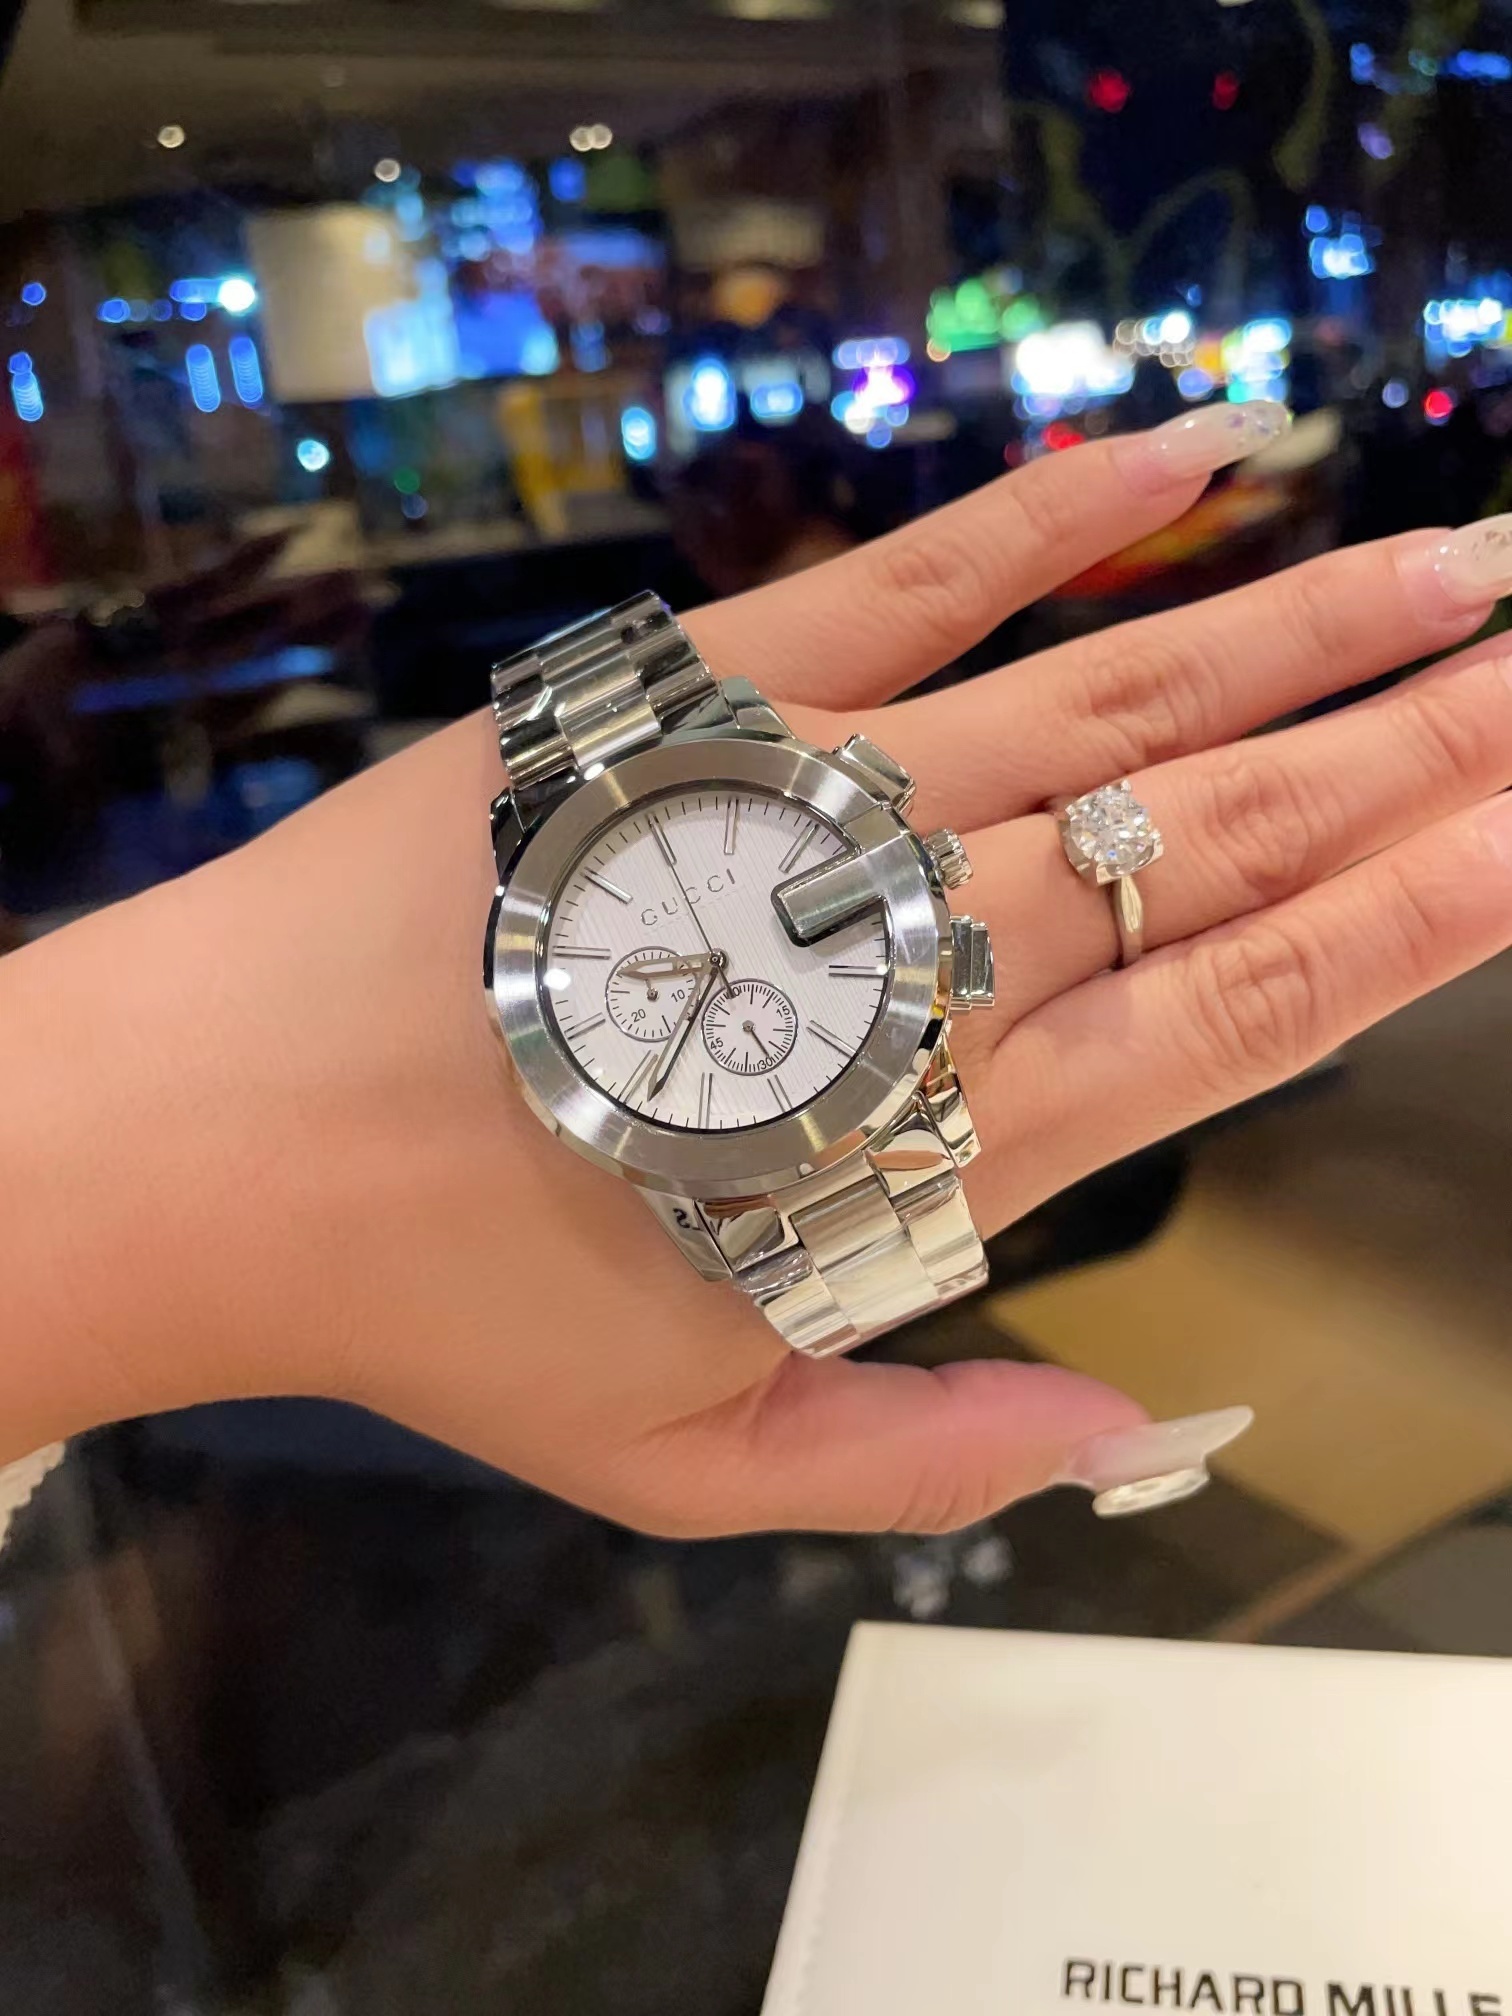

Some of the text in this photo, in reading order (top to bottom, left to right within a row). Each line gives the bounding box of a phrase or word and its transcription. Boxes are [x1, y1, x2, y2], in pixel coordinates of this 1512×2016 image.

[641, 868, 735, 926] GUCCI
[671, 989, 686, 1003] 10
[631, 1008, 646, 1023] 20
[776, 1005, 791, 1018] 15
[710, 1037, 724, 1051] 45
[1064, 1958, 1305, 2016] RICHARD
